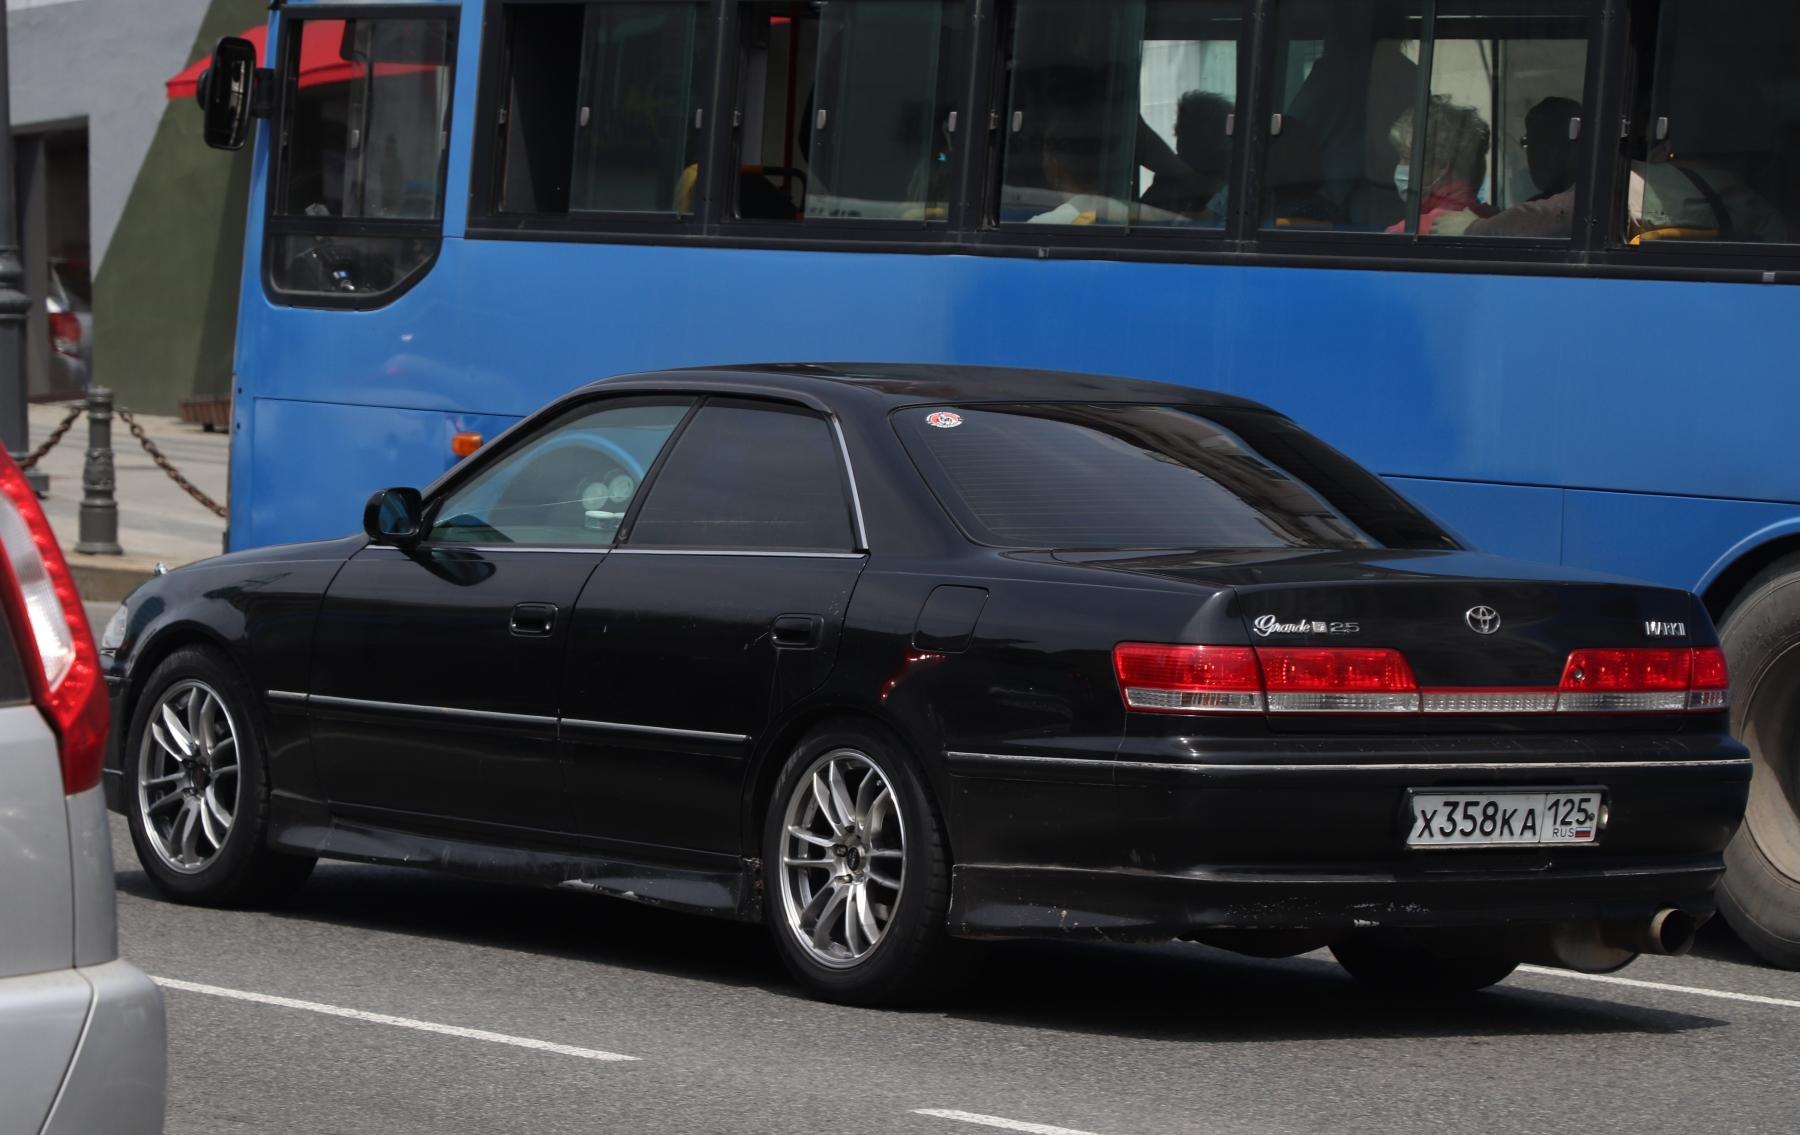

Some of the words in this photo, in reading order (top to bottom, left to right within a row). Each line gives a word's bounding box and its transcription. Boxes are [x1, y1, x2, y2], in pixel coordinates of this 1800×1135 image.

[1253, 614, 1310, 637] Grande
[1547, 798, 1591, 826] 125
[1552, 827, 1575, 838] RUS
